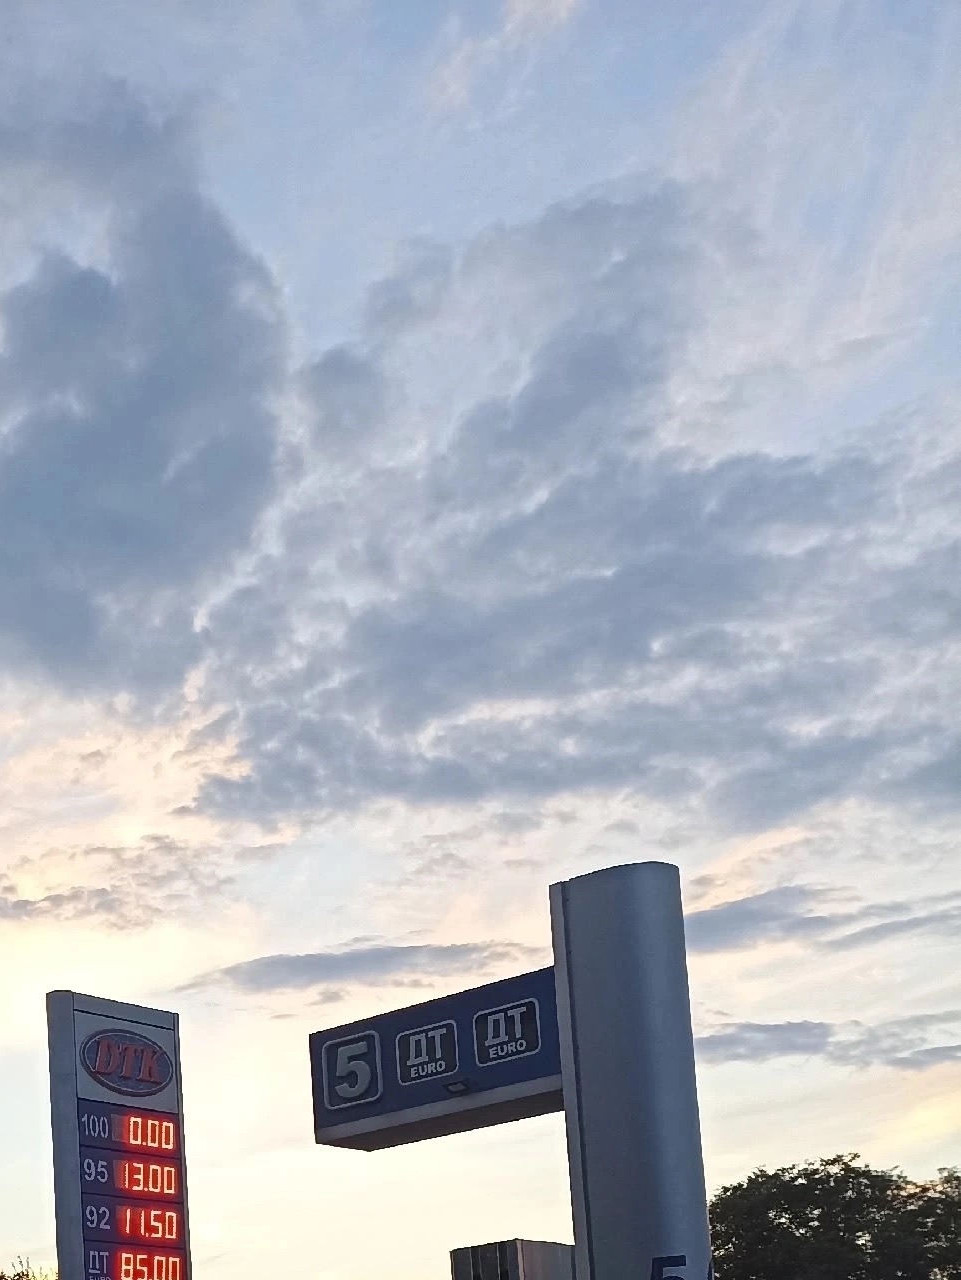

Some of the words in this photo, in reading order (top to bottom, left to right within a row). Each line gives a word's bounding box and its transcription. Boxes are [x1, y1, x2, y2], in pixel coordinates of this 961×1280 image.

[335, 1041, 372, 1098] 5
[406, 1028, 447, 1066] ДТ
[485, 1007, 527, 1047] ДТ
[489, 1040, 527, 1059] EURO
[410, 1060, 446, 1078] EURO
[81, 1113, 109, 1139] 100
[129, 1116, 174, 1150] 0.00
[83, 1158, 109, 1183] 95
[124, 1162, 176, 1194] 13.00
[85, 1205, 111, 1230] 92
[125, 1208, 177, 1239] 11.50
[89, 1250, 109, 1274] ДТ
